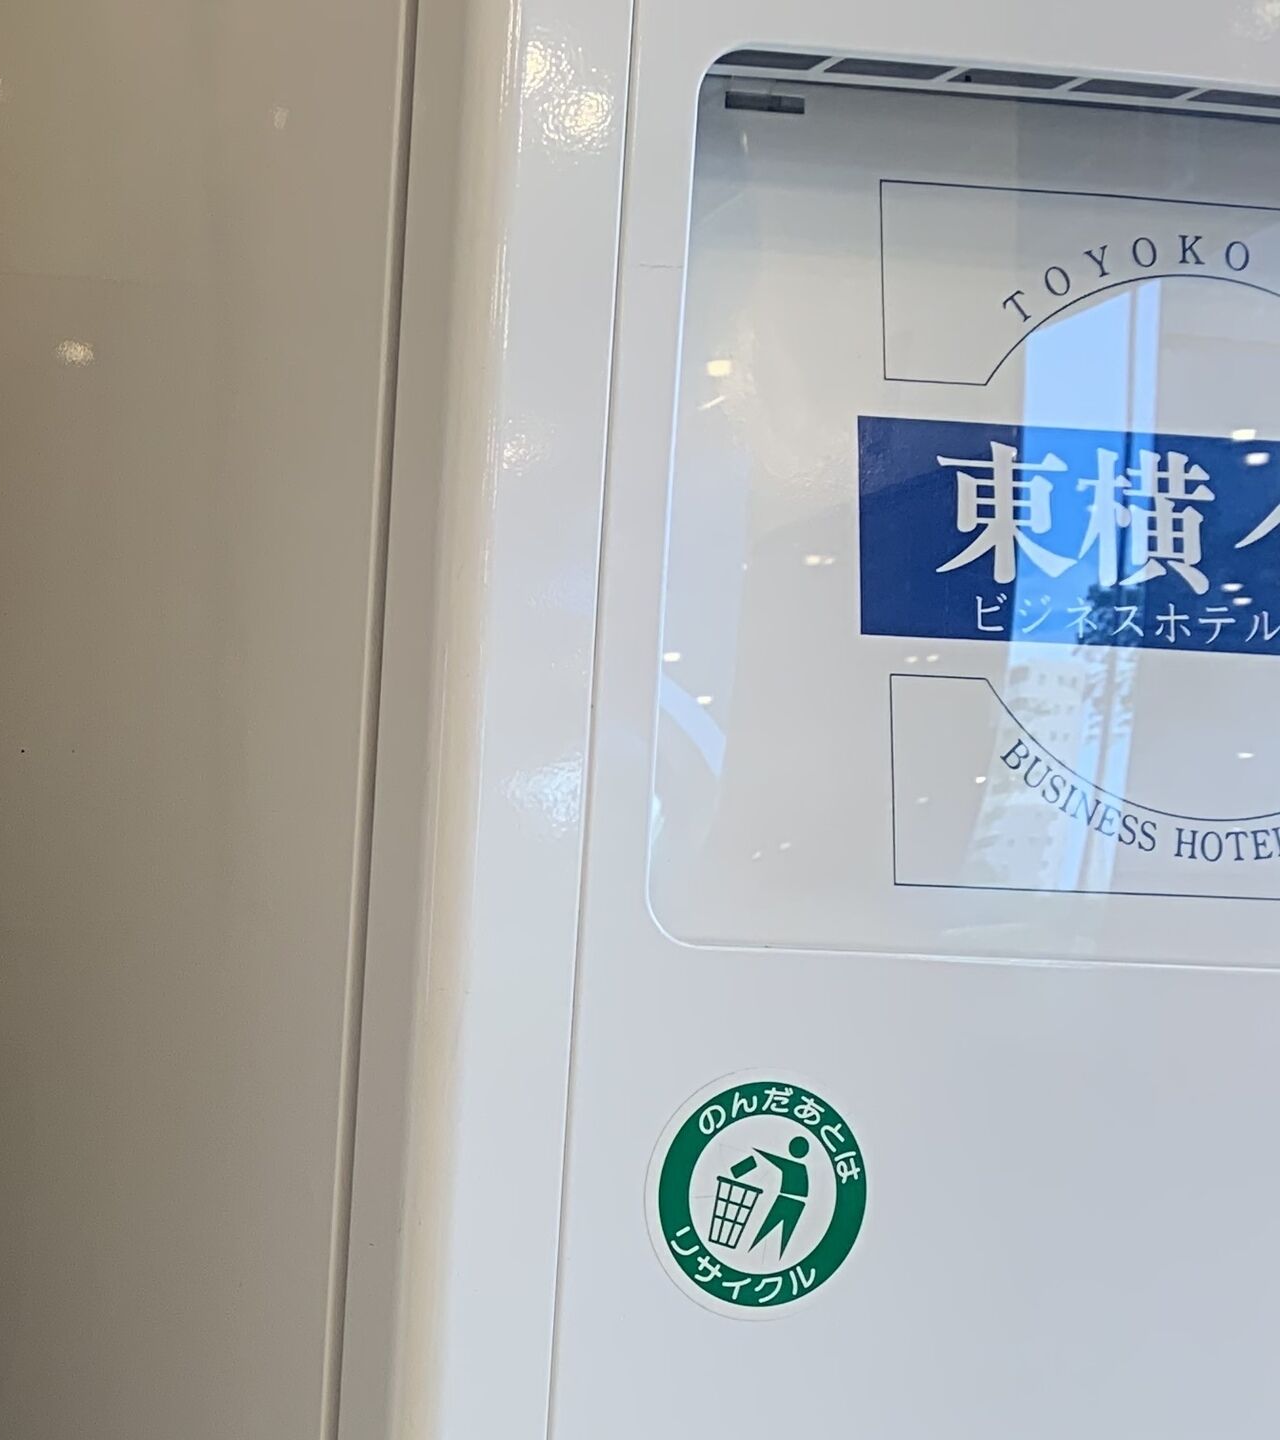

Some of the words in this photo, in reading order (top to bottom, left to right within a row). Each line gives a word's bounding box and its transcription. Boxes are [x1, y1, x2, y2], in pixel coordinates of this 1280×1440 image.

[1003, 235, 1250, 322] TOYOKO
[975, 593, 1280, 645] ビジネスホテル
[1000, 738, 1157, 852] BUSINESS
[698, 1086, 861, 1185] のんだあとは
[670, 1226, 816, 1304] リサイクル
